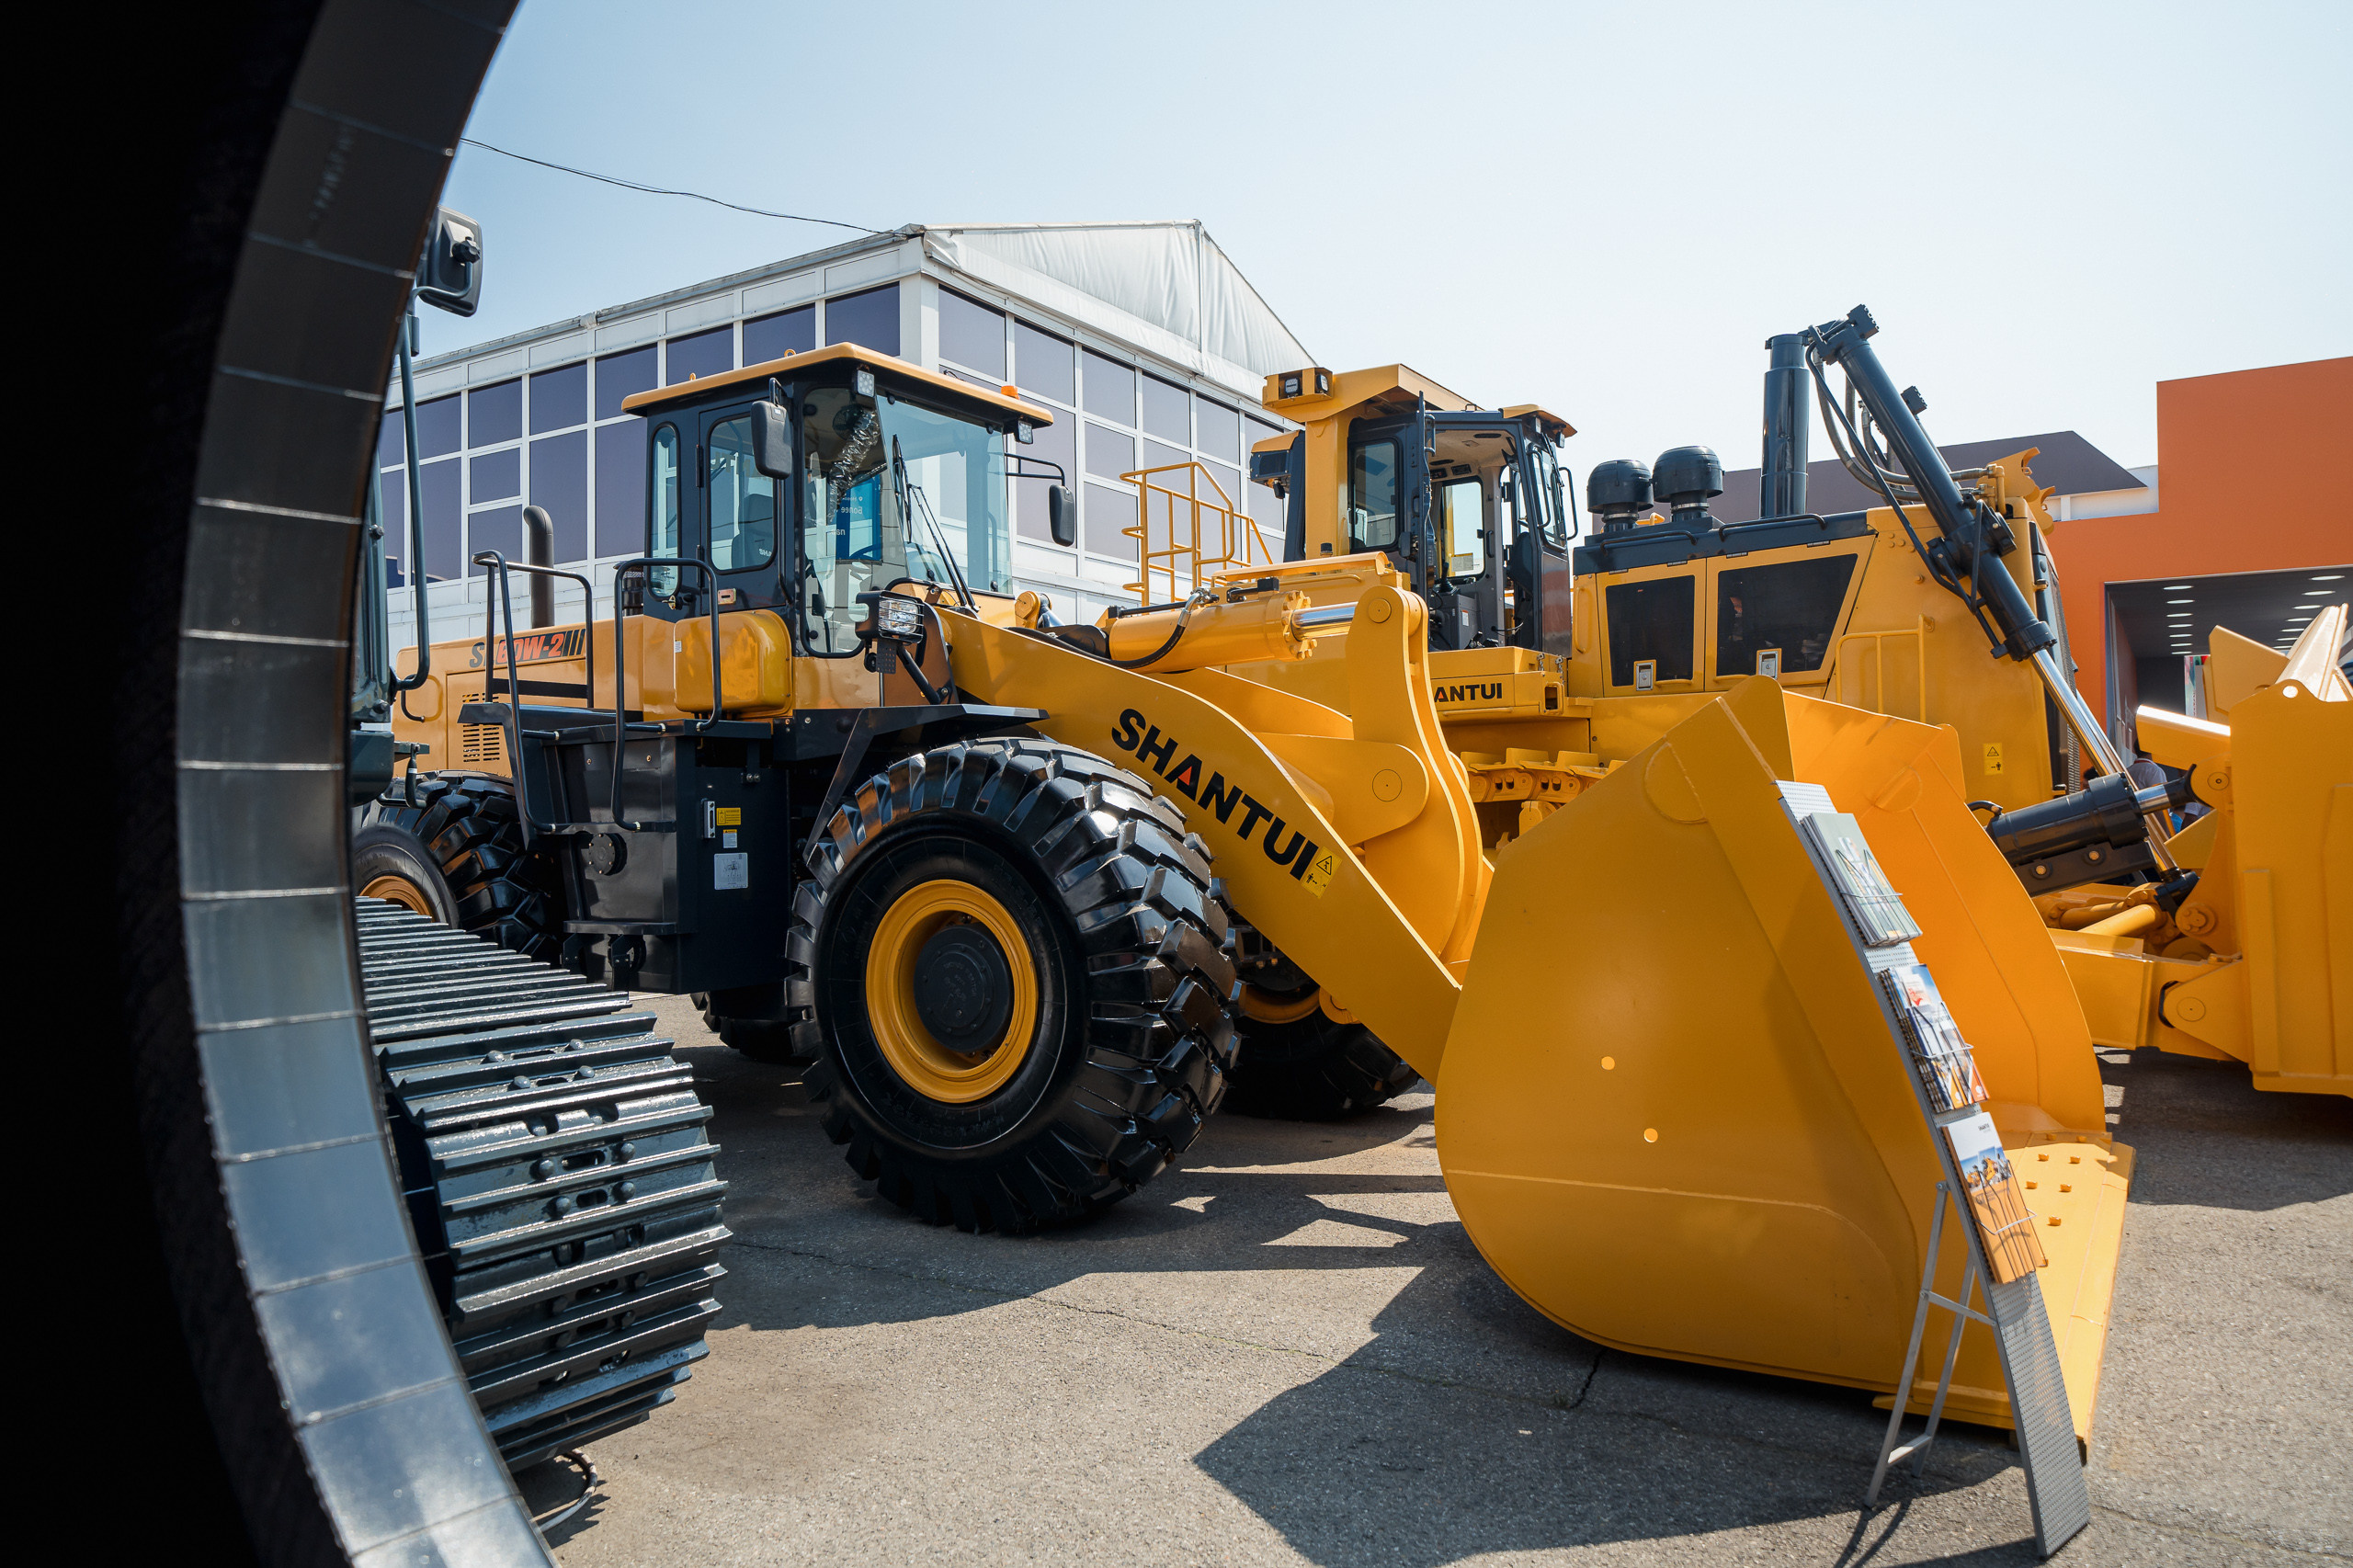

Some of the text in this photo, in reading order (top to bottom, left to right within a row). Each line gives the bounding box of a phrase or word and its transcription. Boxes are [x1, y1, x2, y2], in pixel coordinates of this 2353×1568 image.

[469, 633, 564, 668] S60W-2
[1435, 683, 1502, 702] ANTUI
[1111, 709, 1319, 881] SHANTUI
